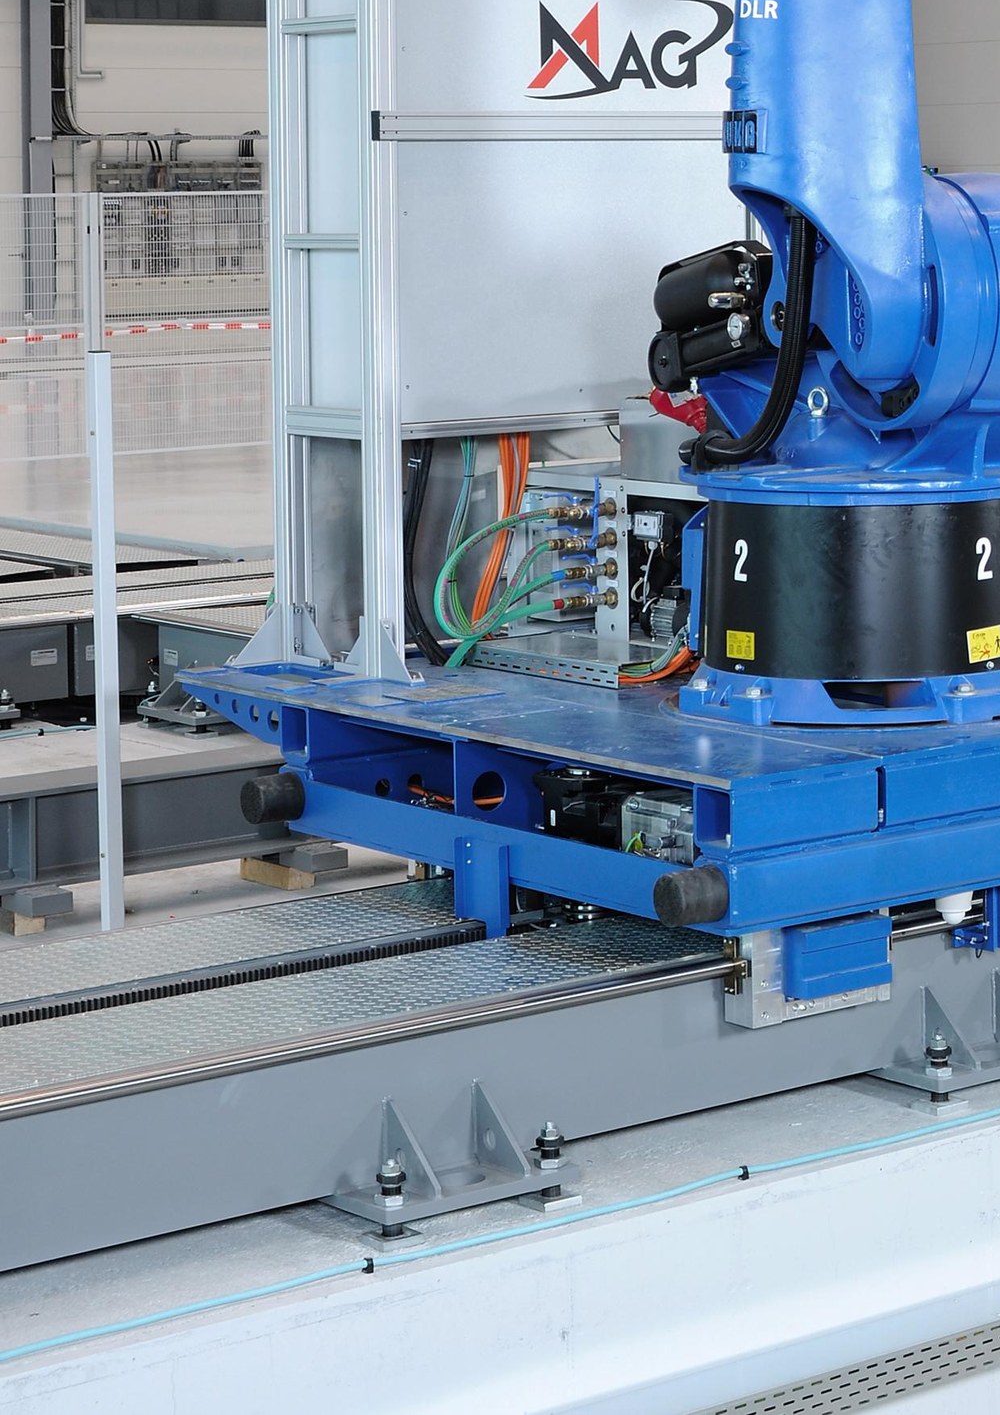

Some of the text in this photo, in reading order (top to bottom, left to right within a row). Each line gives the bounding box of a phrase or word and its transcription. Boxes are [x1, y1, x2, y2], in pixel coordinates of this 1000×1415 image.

[740, 0, 779, 19] DLR
[524, 0, 734, 100] MAG
[734, 538, 748, 581] 2
[976, 537, 993, 580] 2
